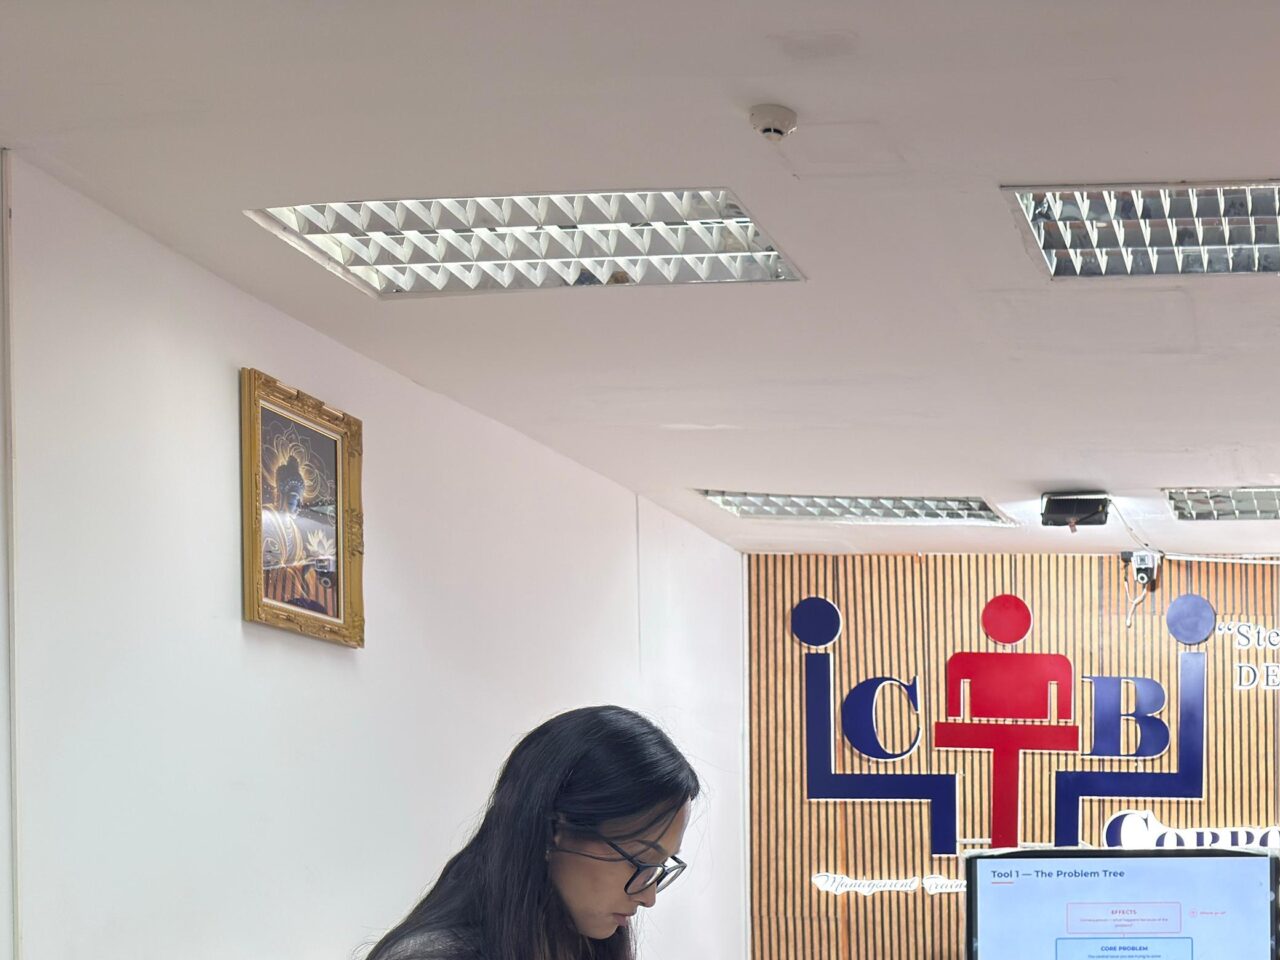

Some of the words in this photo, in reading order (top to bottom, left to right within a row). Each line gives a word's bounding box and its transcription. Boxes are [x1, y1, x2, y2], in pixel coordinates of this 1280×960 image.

[991, 870, 1013, 878] Tool
[1016, 870, 1020, 878] 1
[1034, 870, 1053, 878] The
[1056, 870, 1100, 878] Problem
[1102, 869, 1125, 878] Tree
[925, 875, 967, 891] Train
